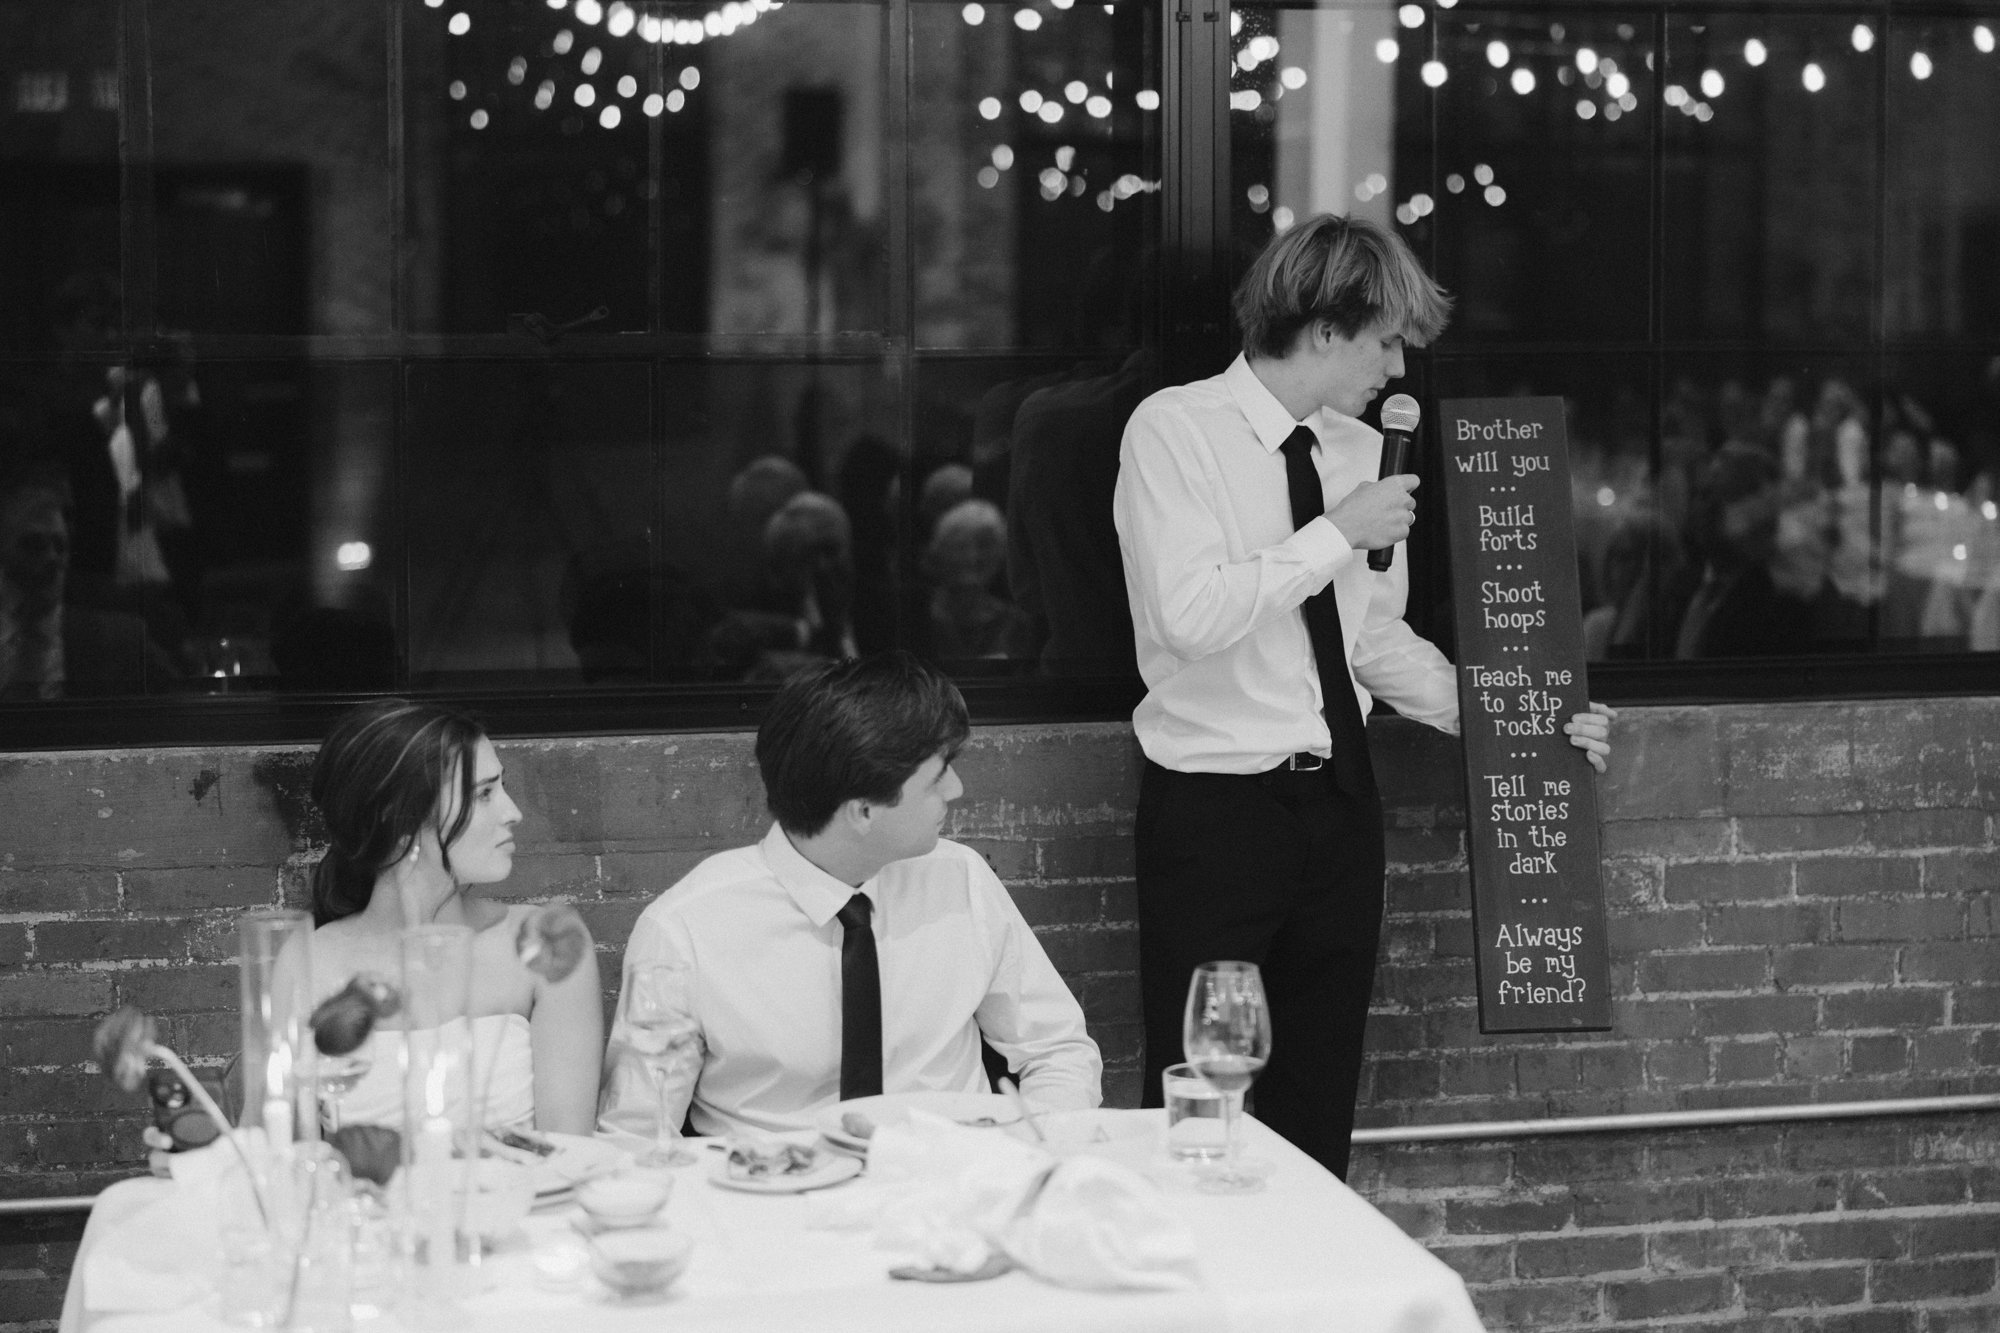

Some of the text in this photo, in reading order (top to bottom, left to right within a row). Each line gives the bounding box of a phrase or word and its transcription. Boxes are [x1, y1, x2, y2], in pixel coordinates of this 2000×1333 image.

[1457, 419, 1543, 440] Brother
[1455, 451, 1551, 477] will you
[1479, 505, 1534, 526] Build
[1480, 529, 1537, 551] forts
[1482, 581, 1544, 603] Shoot
[1484, 608, 1545, 633] hoops
[1466, 665, 1572, 687] Teach me
[1480, 691, 1505, 713] to
[1484, 775, 1570, 797] Tell me
[1491, 800, 1569, 821] stories
[1497, 826, 1567, 848] in the
[1495, 924, 1582, 951] Always
[1505, 951, 1575, 978] be my
[1498, 978, 1586, 1004] friend?
